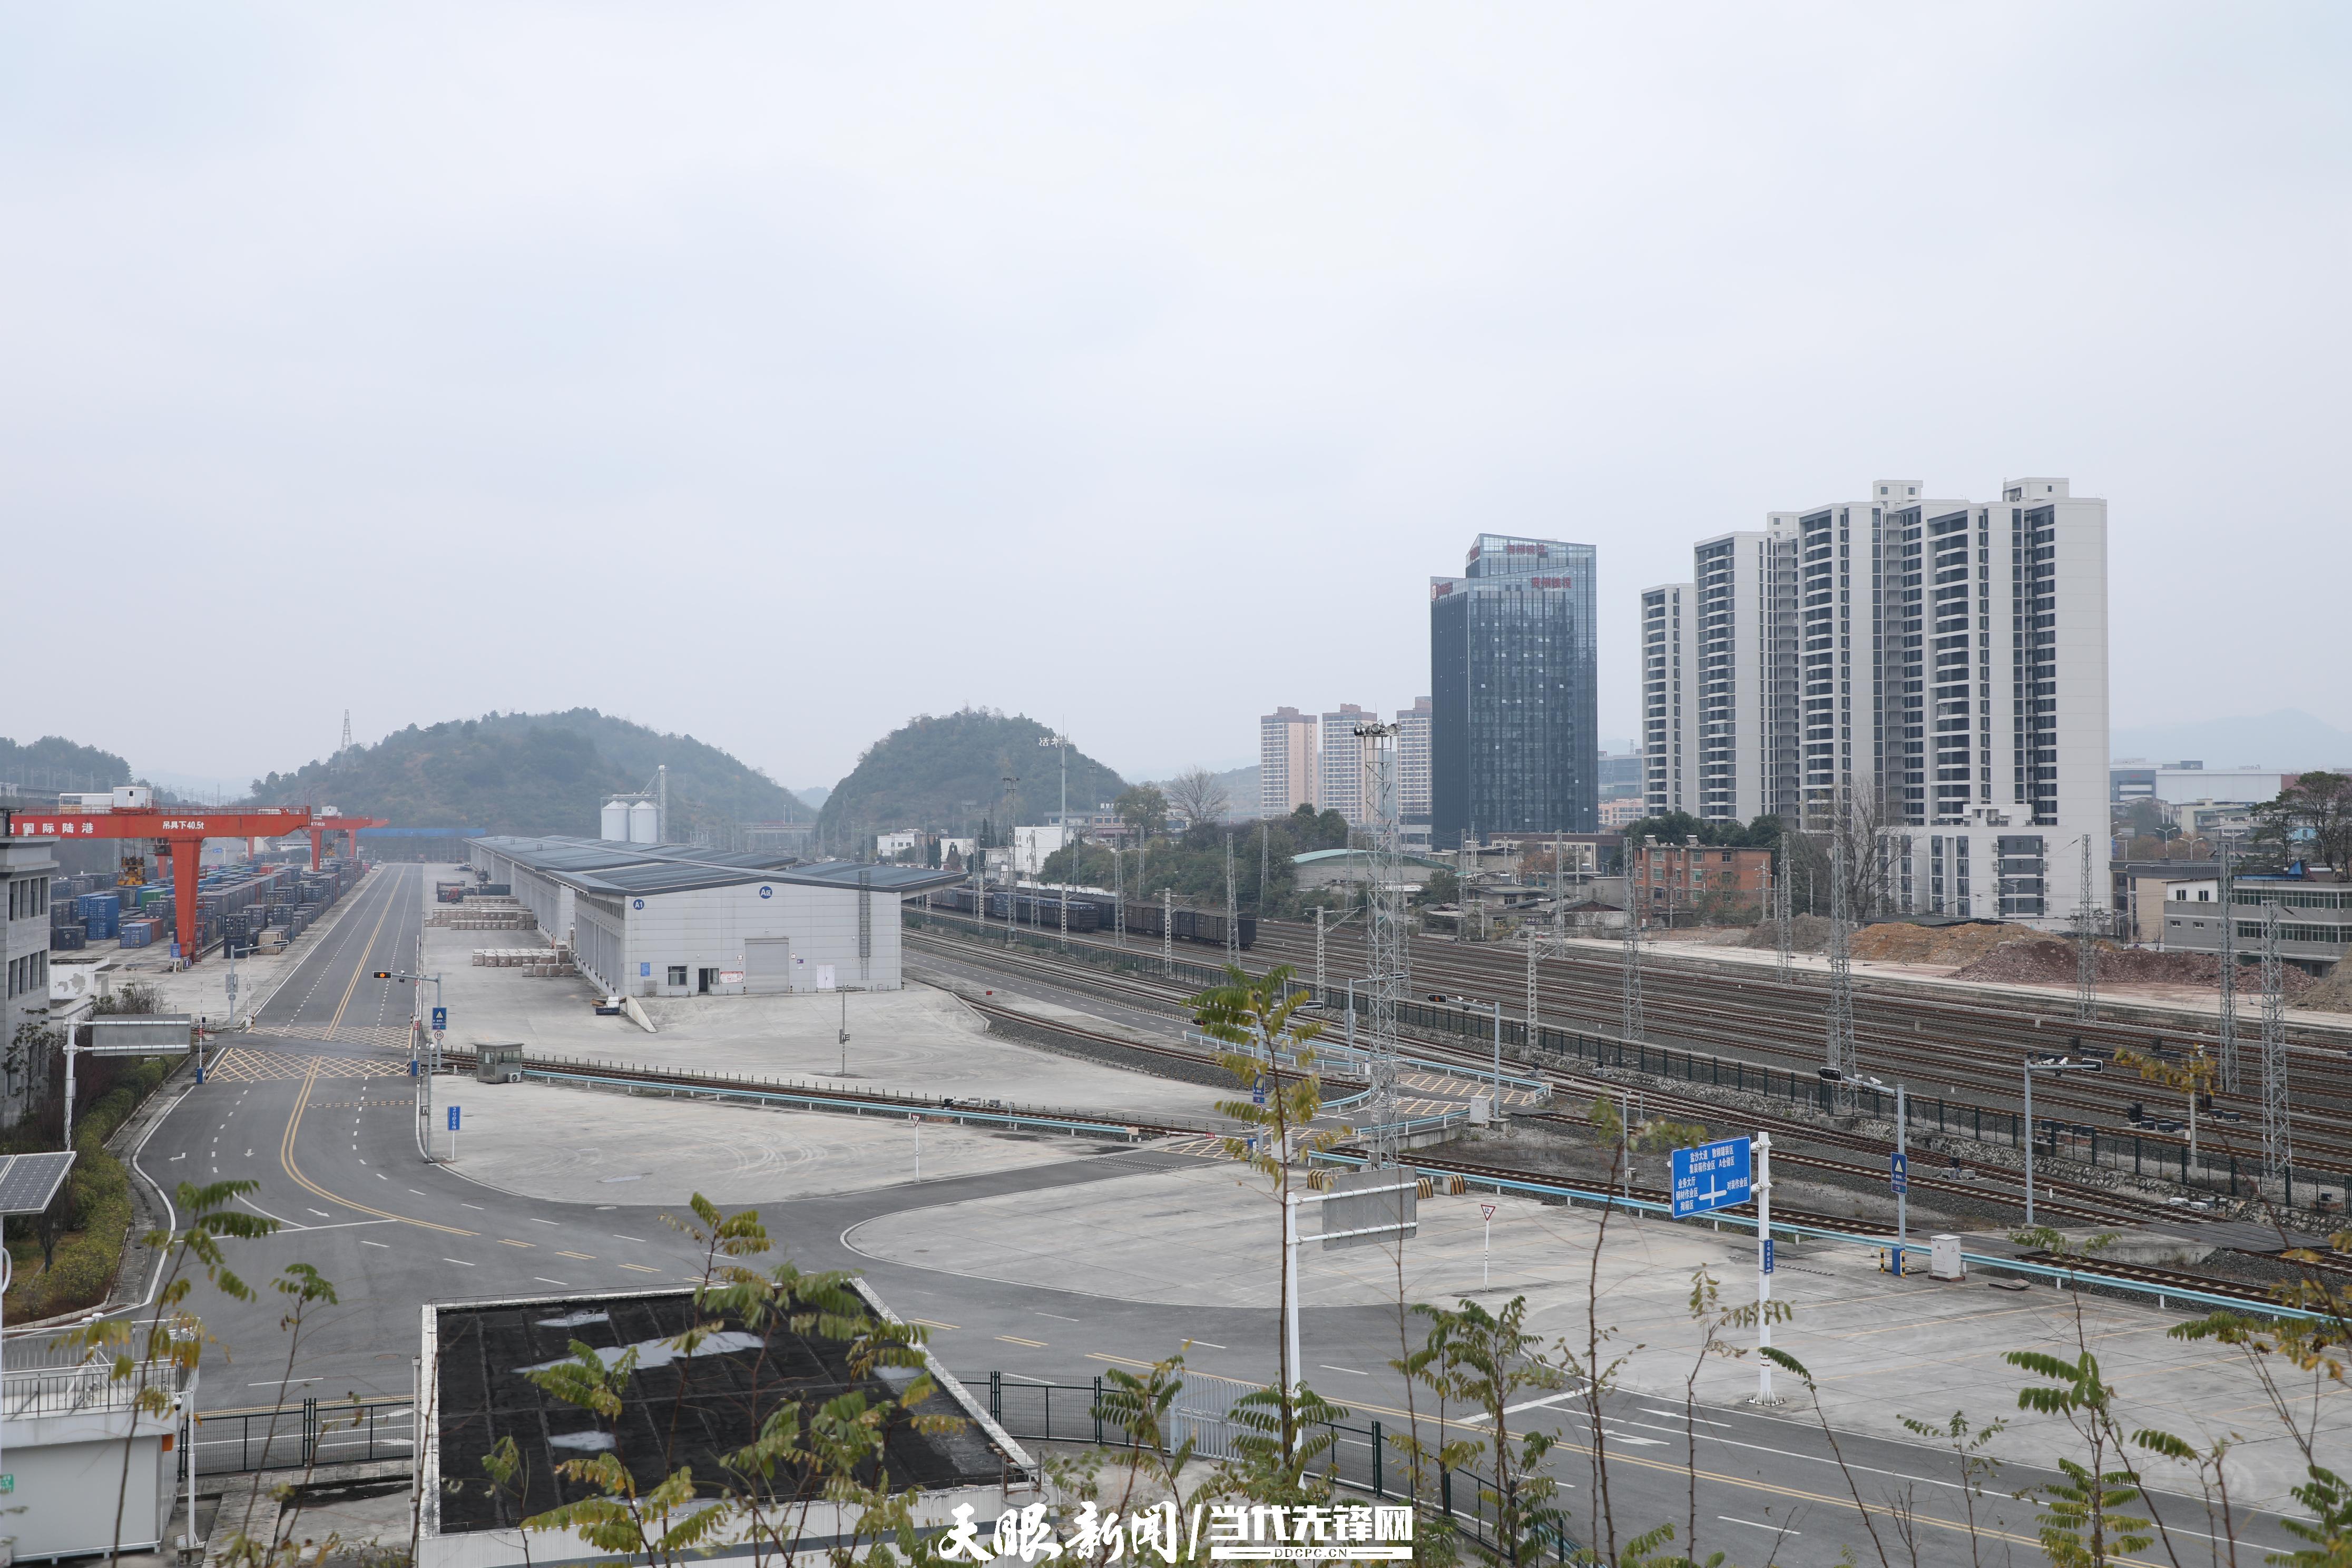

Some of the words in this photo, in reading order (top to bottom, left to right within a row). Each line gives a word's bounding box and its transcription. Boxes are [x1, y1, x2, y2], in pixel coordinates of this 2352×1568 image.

[162, 821, 204, 830] 吊具下40.5t
[1689, 1160, 1716, 1174] 集装箱作业区
[1678, 1177, 1696, 1189] 业务大厅
[1676, 1187, 1698, 1201] 钢材作业区
